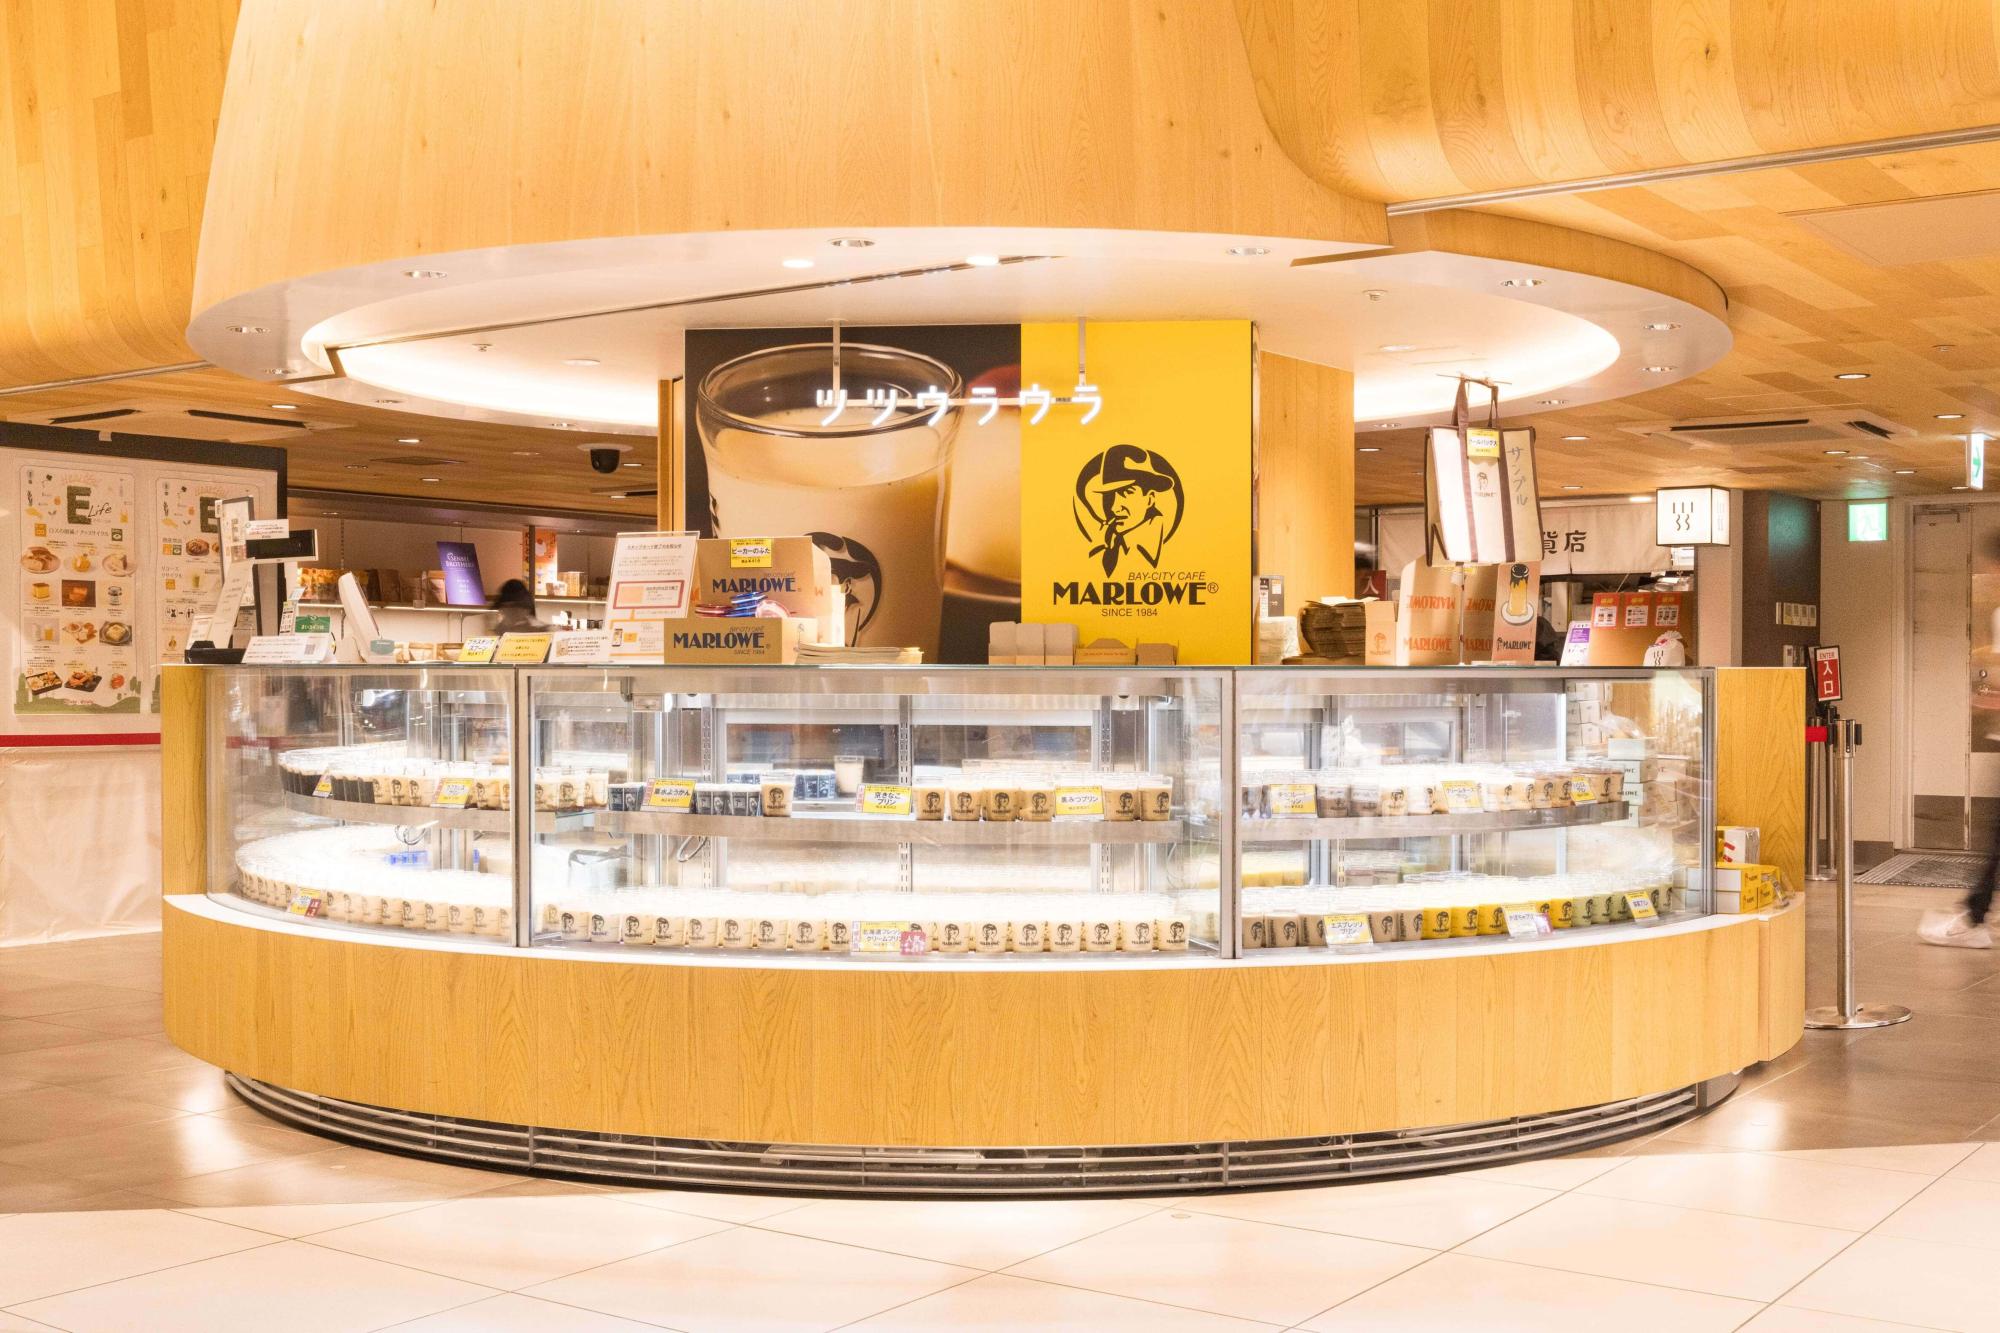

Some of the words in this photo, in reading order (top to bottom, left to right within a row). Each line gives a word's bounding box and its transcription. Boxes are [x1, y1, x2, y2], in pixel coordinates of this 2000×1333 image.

[816, 384, 1102, 427] ツツウラウラ
[88, 502, 112, 518] Life
[731, 547, 771, 556] ビーカーのふた
[1128, 572, 1175, 581] BAY-CITY
[1177, 571, 1206, 581] CAFE
[712, 577, 796, 594] MARLOWE
[1053, 581, 1207, 605] MARLOWE
[1101, 608, 1133, 617] SINCE
[1136, 608, 1158, 617] 1984
[673, 632, 765, 649] MARLOWE
[1503, 640, 1532, 650] MARLOWE
[1819, 651, 1835, 660] ENTER
[1822, 661, 1835, 695] 入口
[877, 798, 897, 806] プリン
